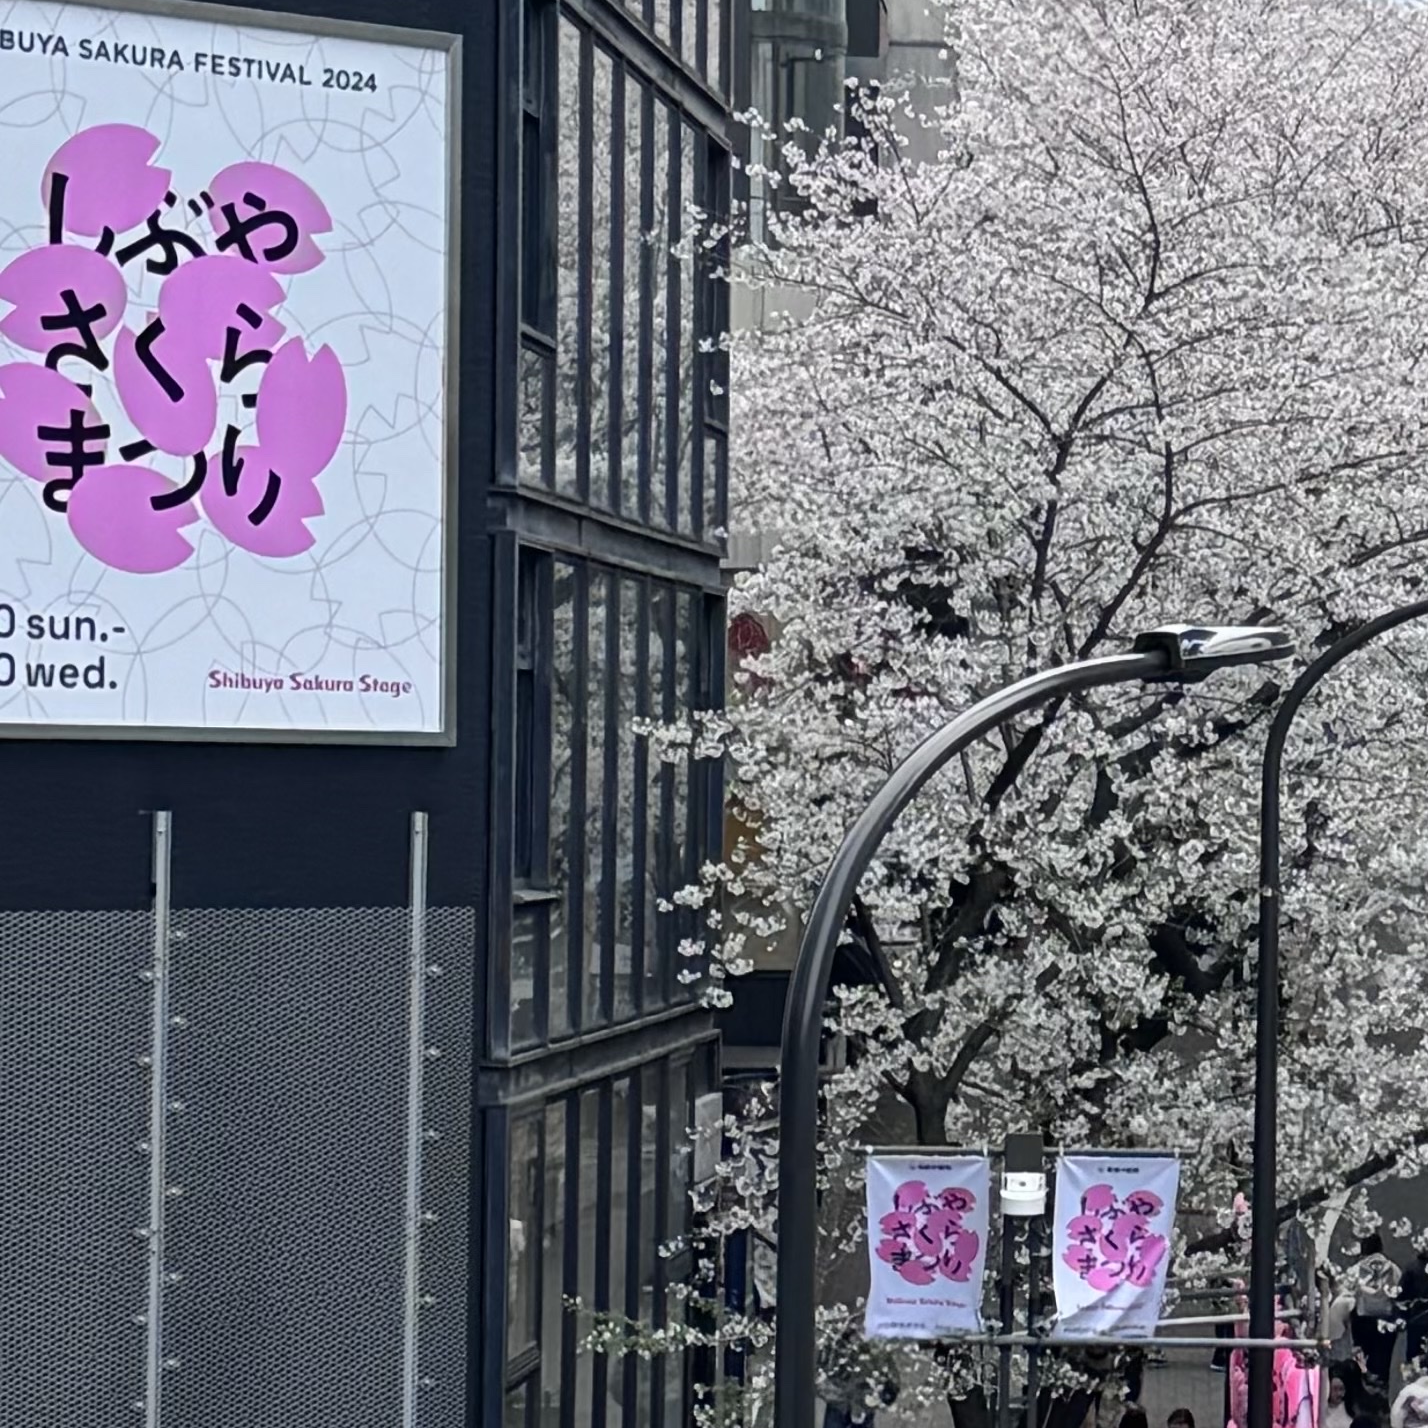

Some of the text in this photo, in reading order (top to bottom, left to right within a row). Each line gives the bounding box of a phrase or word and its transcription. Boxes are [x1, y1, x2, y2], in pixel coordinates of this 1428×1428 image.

[78, 39, 185, 71] SAKURA
[194, 53, 313, 86] FESTIVAL
[322, 68, 378, 93] 2024
[49, 172, 299, 275] しぶや
[39, 288, 275, 408] さくら
[37, 409, 281, 527] まつり
[26, 656, 117, 689] wed.
[208, 671, 412, 697] Shibuya Sakura Stage
